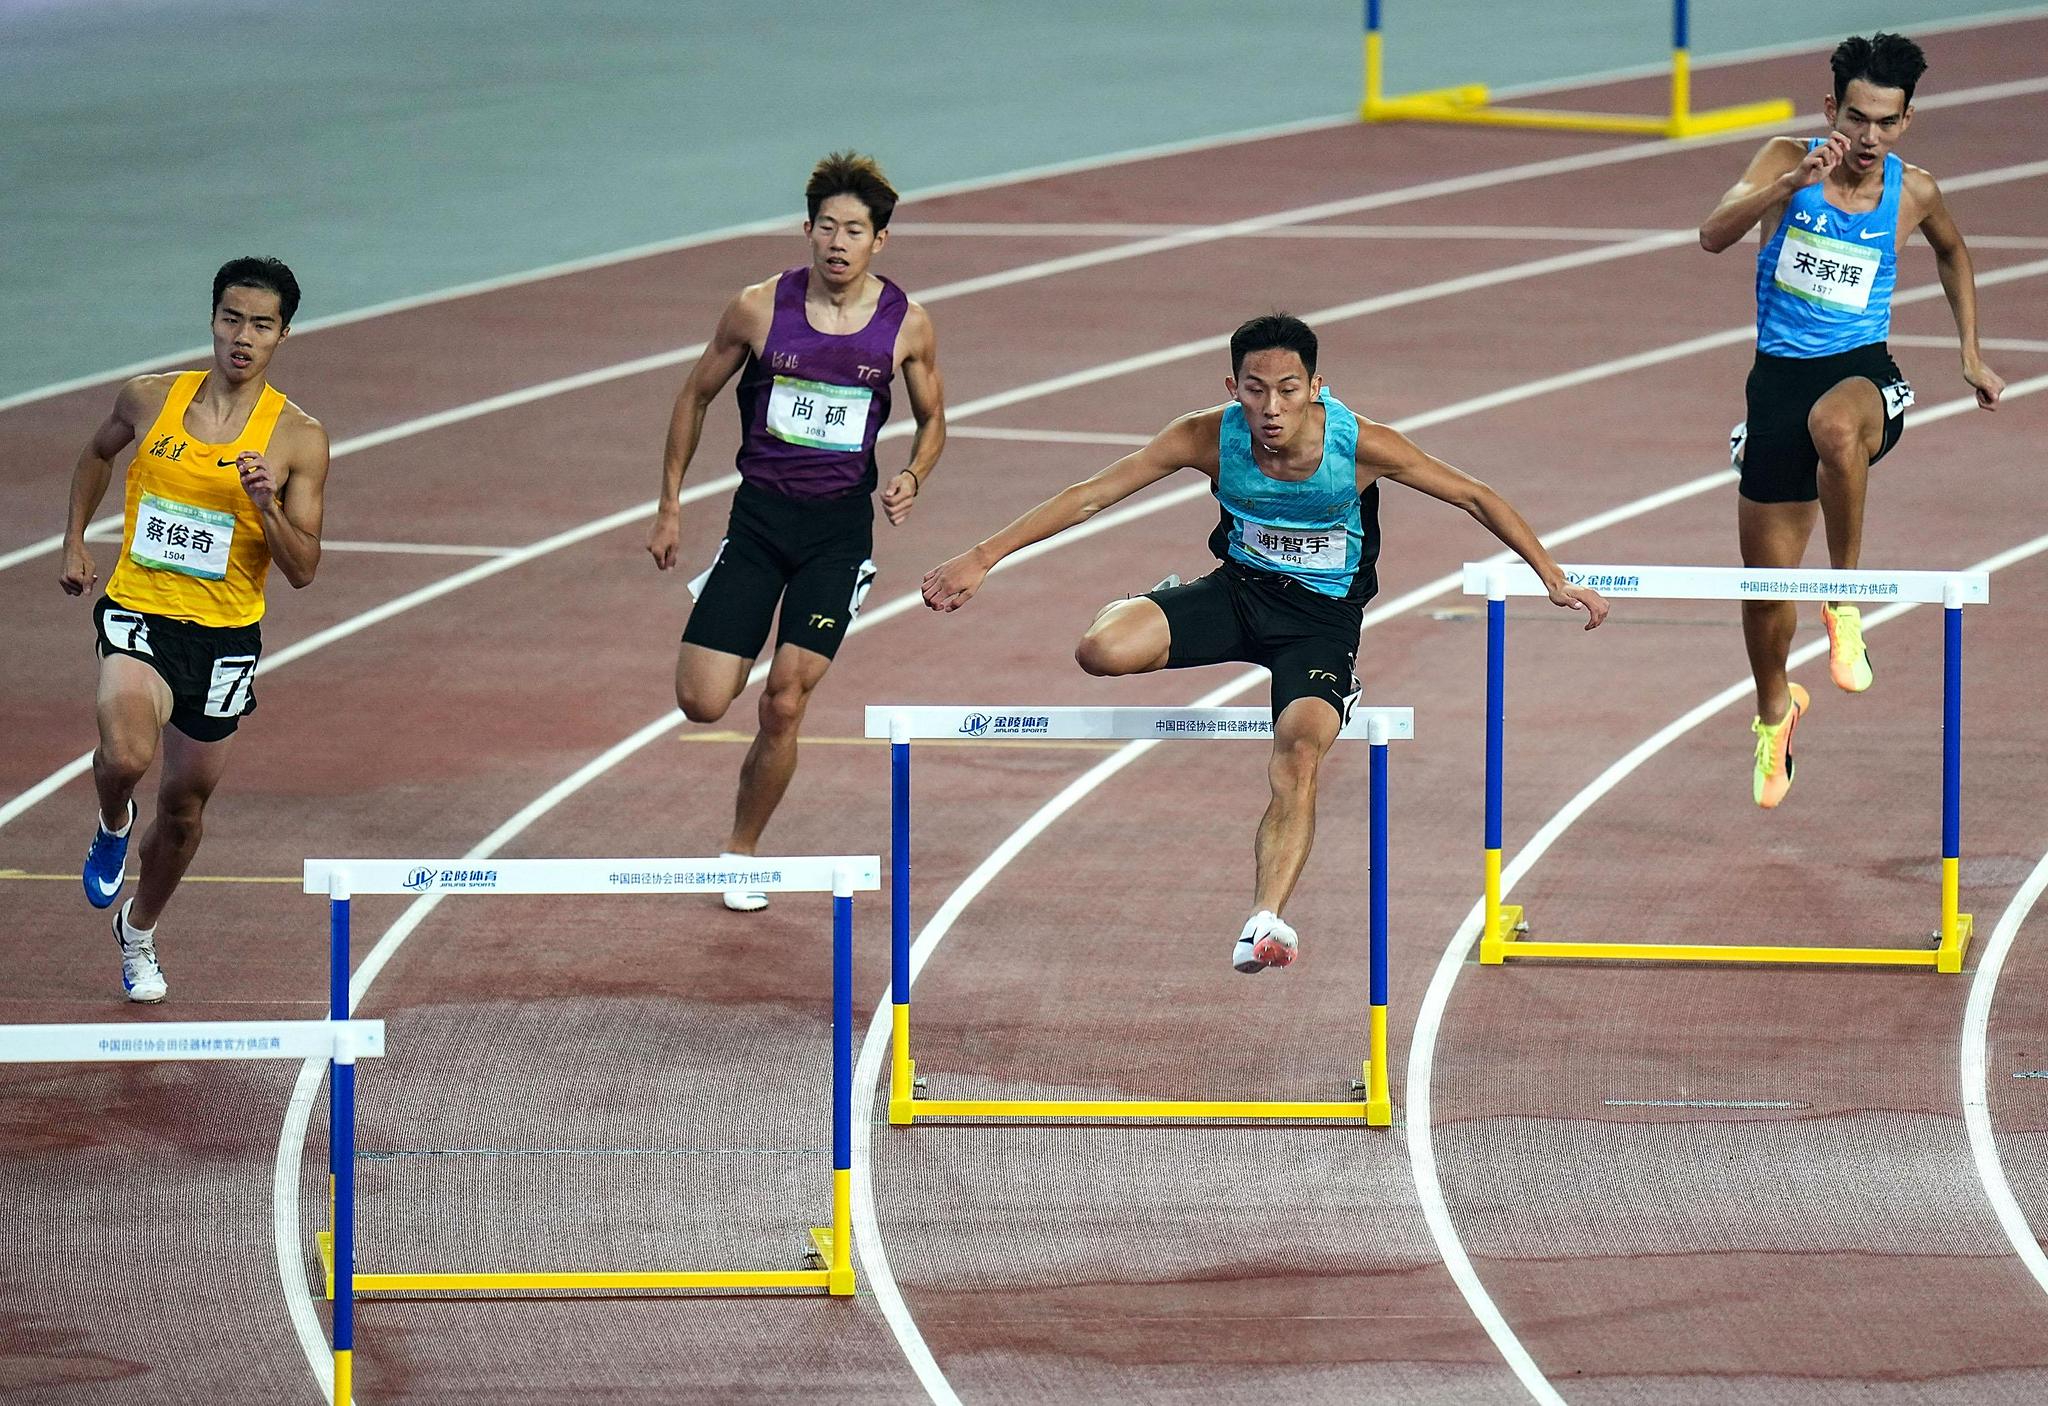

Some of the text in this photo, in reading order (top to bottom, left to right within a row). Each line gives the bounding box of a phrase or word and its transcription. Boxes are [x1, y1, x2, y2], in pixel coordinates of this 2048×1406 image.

[1793, 252, 1863, 287] 宋家辉
[1811, 283, 1833, 295] 1577
[791, 395, 848, 426] 尚硕
[805, 426, 826, 438] 1083
[145, 516, 214, 554] 蔡俊奇
[1256, 530, 1330, 554] 谢智宇
[163, 550, 185, 562] 1504
[1281, 553, 1303, 565] 1641
[1588, 575, 1639, 586] 金陵体育
[1739, 580, 1900, 595] 中国田径协会田径器材类官方供应商
[110, 613, 148, 650] 7
[218, 659, 255, 713] 7
[994, 716, 1049, 727] 金陵体育
[440, 870, 497, 882] 金陵体育
[608, 870, 783, 886] 中国田径协会田径器材类官方供应商
[98, 1036, 282, 1054] 中国田径协会田径器材类官方供应商
